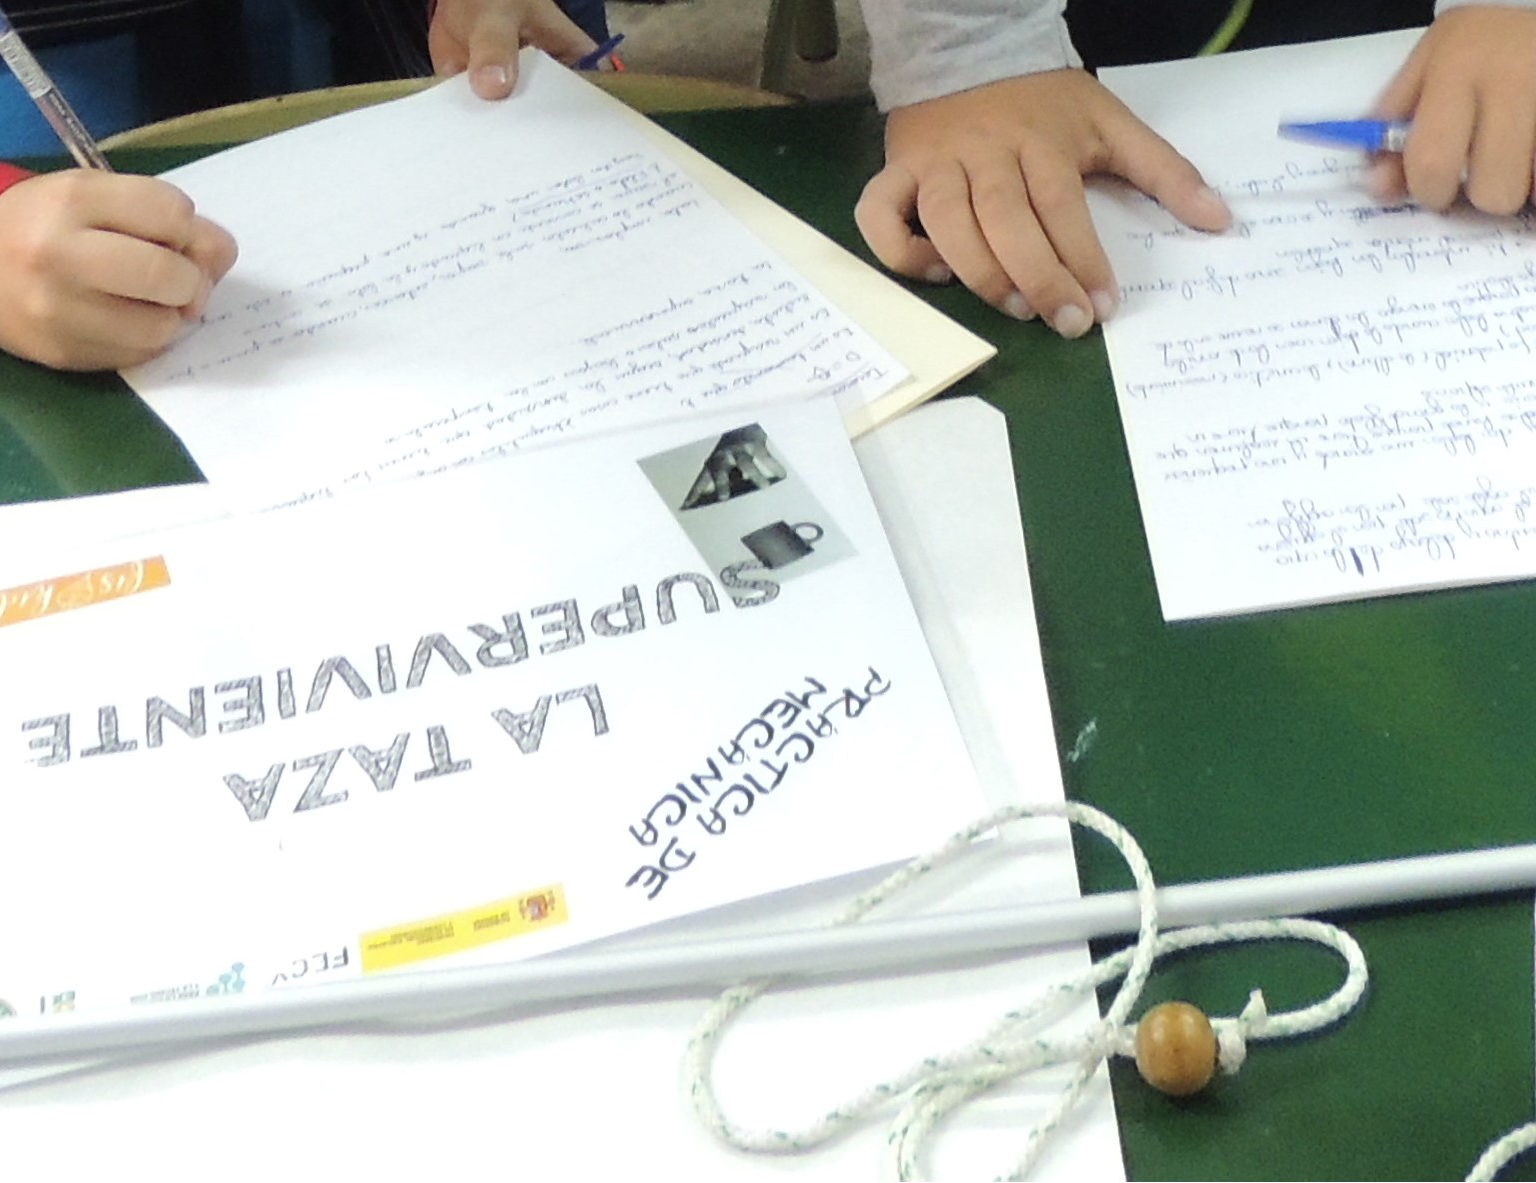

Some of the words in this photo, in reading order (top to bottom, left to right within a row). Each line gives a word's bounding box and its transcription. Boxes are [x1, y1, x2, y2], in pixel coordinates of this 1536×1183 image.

[20, 559, 784, 768] SUPERVIVIENTE
[490, 683, 610, 756] LA
[222, 724, 472, 822] TAZA
[624, 836, 697, 901] DE
